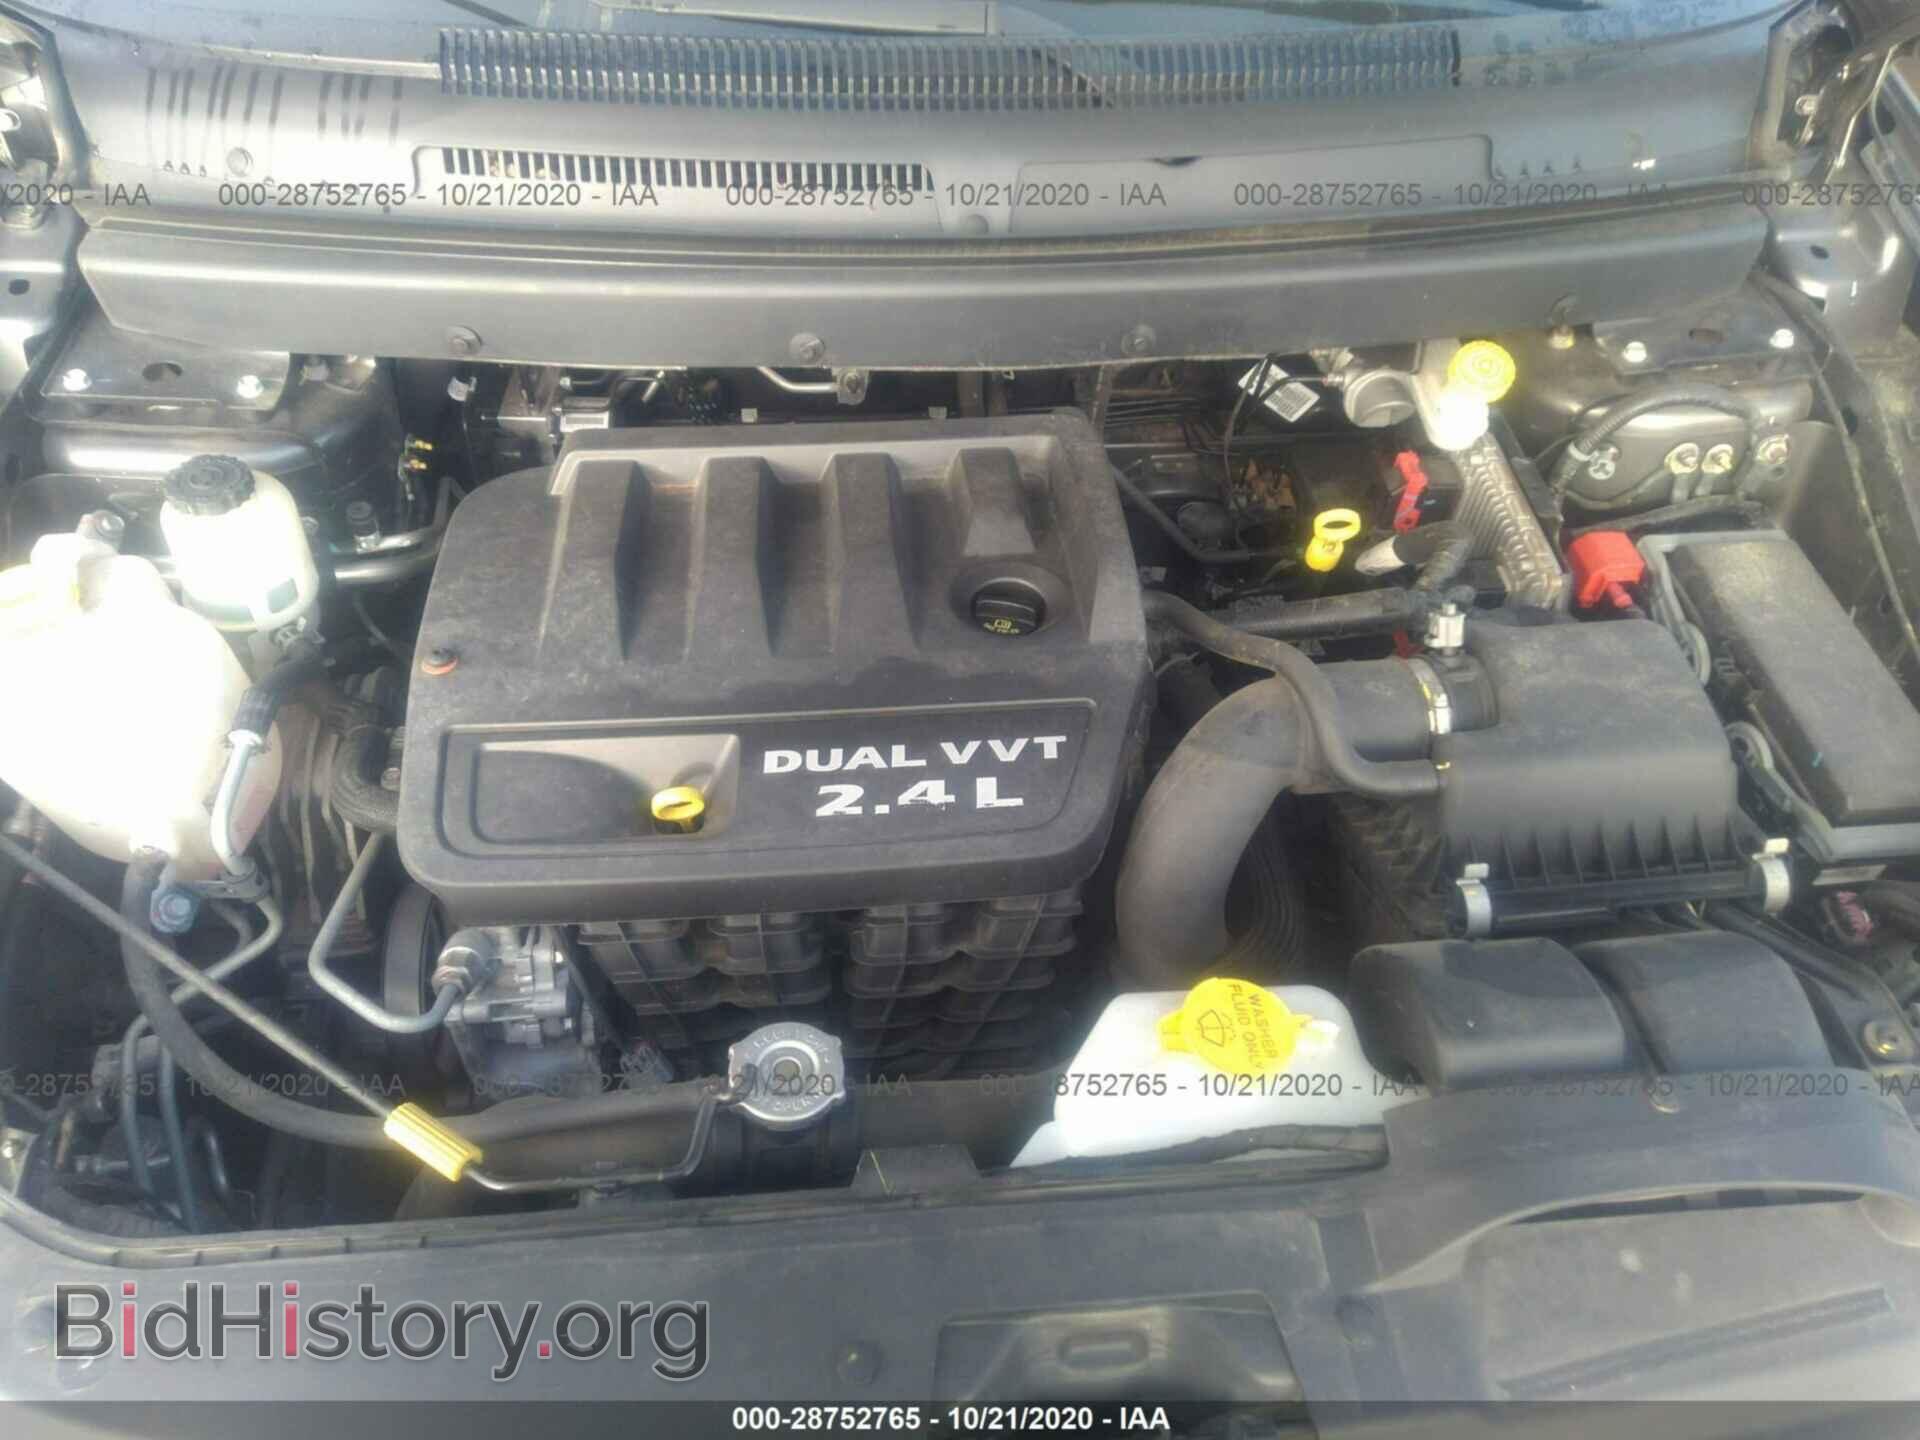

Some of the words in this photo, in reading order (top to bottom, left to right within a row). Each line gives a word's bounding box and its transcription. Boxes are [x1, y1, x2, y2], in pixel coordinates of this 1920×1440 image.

[763, 744, 927, 774] DUAL
[940, 736, 1067, 764] VVT
[1228, 984, 1251, 1026] FLUID
